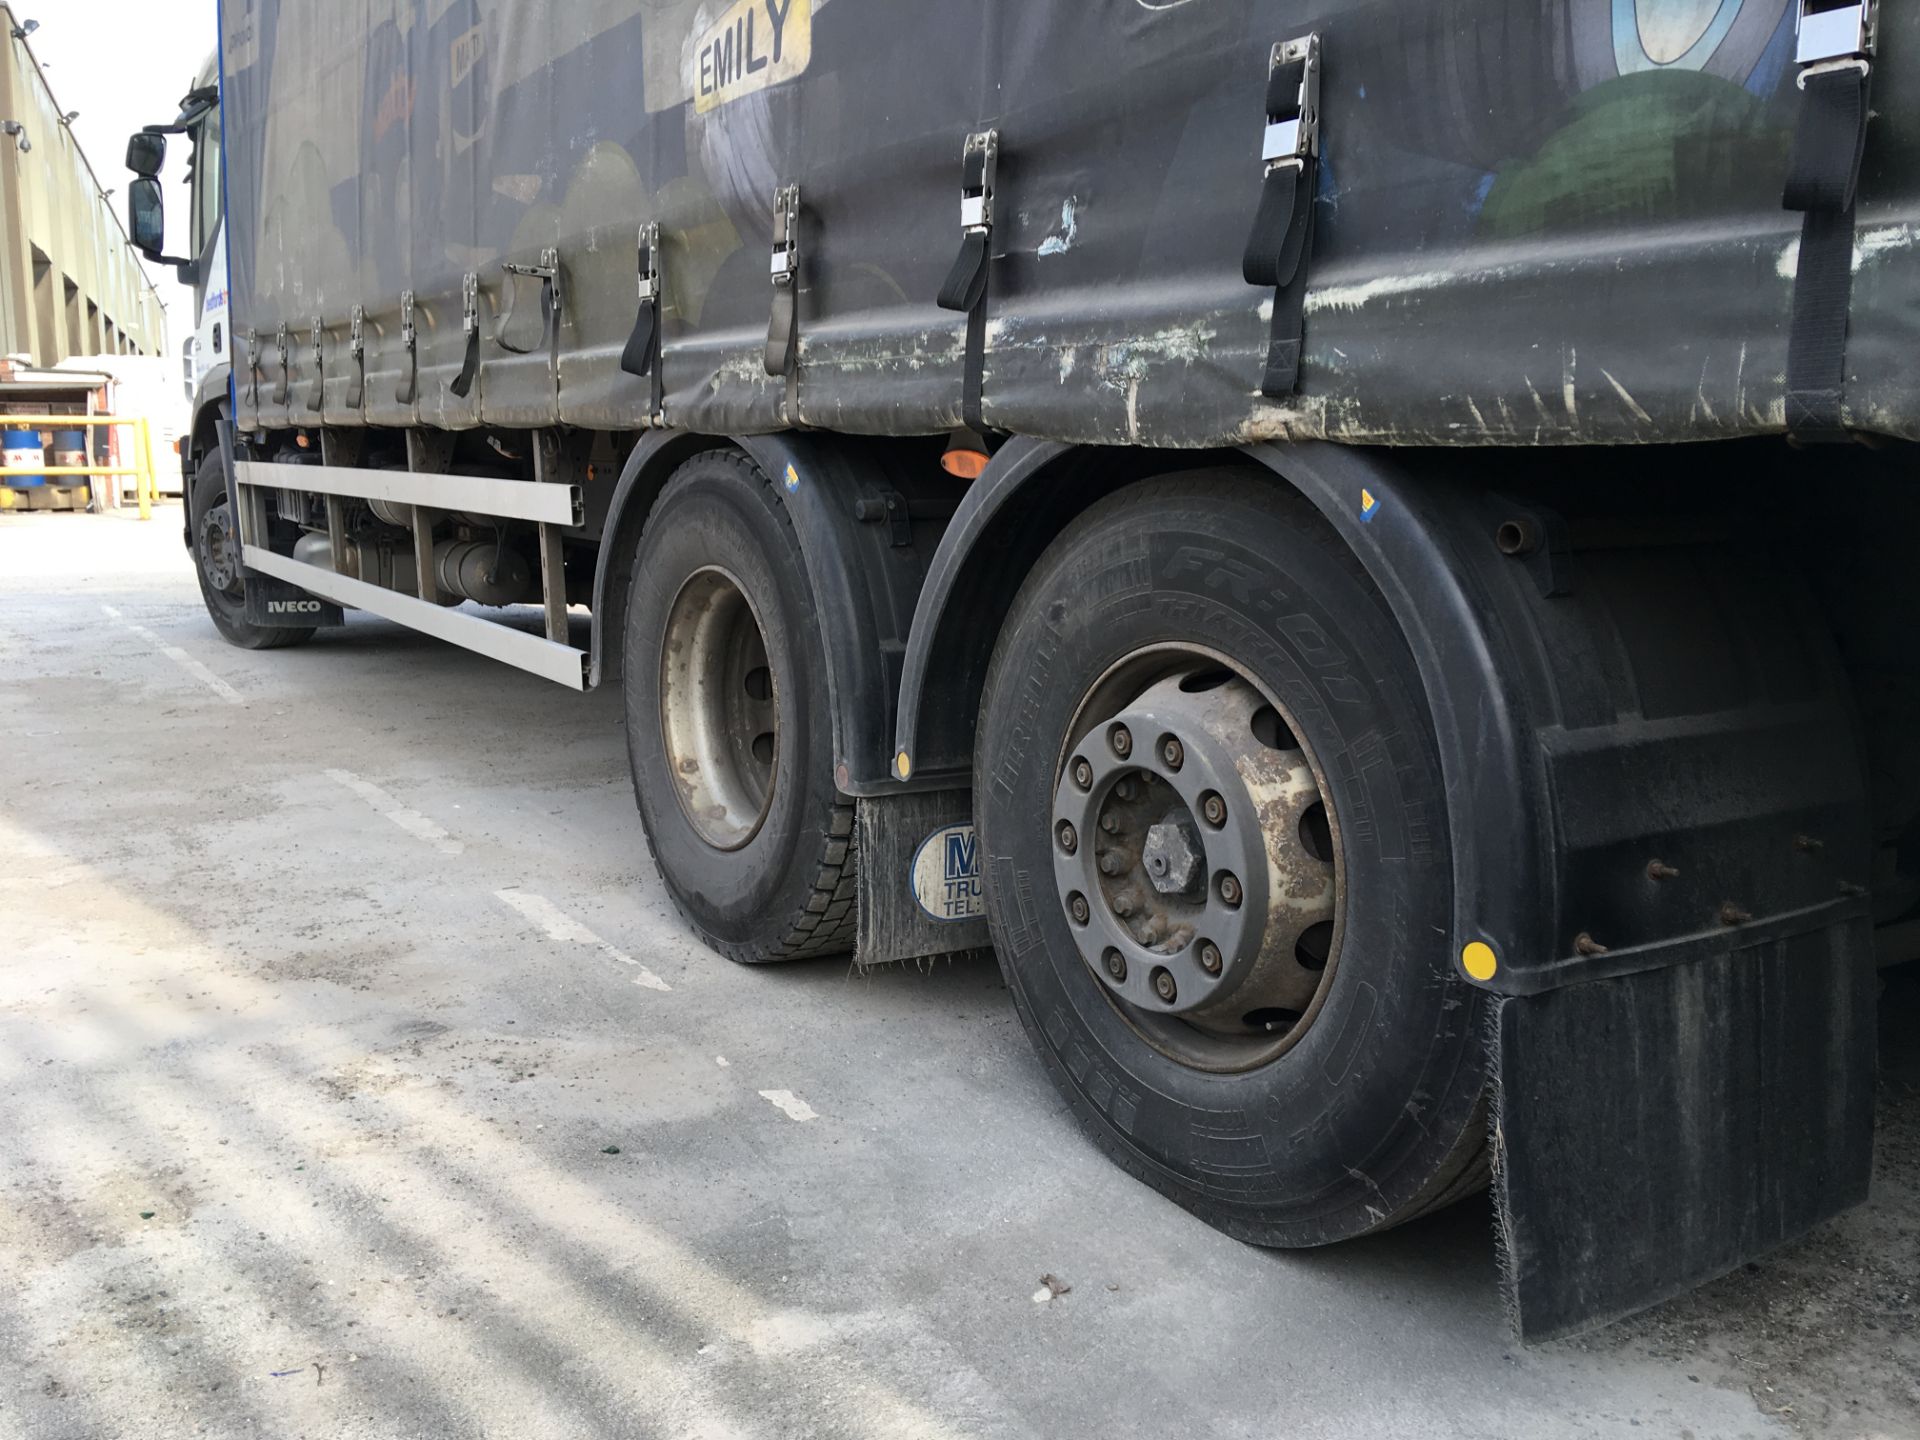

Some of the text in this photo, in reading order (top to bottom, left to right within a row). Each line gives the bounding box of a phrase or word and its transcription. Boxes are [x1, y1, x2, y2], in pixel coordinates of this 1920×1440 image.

[701, 0, 791, 96] EMILY
[268, 600, 321, 613] IVECO
[944, 901, 980, 916] TEL:
